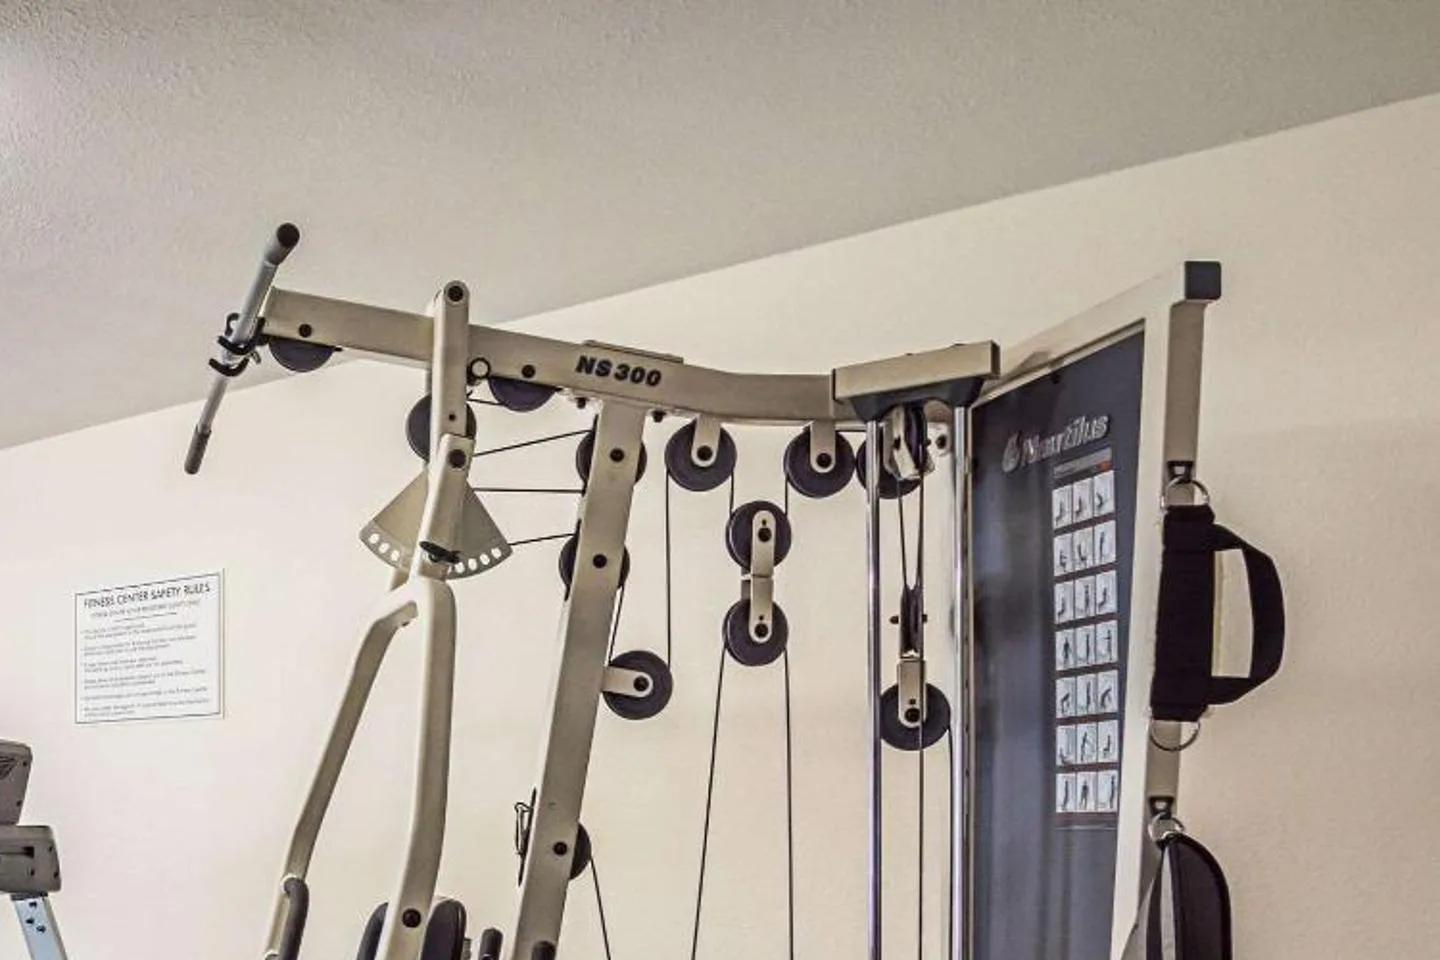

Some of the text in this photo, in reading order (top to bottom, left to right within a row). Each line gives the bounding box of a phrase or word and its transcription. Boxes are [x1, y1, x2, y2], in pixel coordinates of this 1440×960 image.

[1022, 415, 1109, 464] Nautilus
[84, 582, 210, 608] FITNESS CENTER SAFETY RULES
